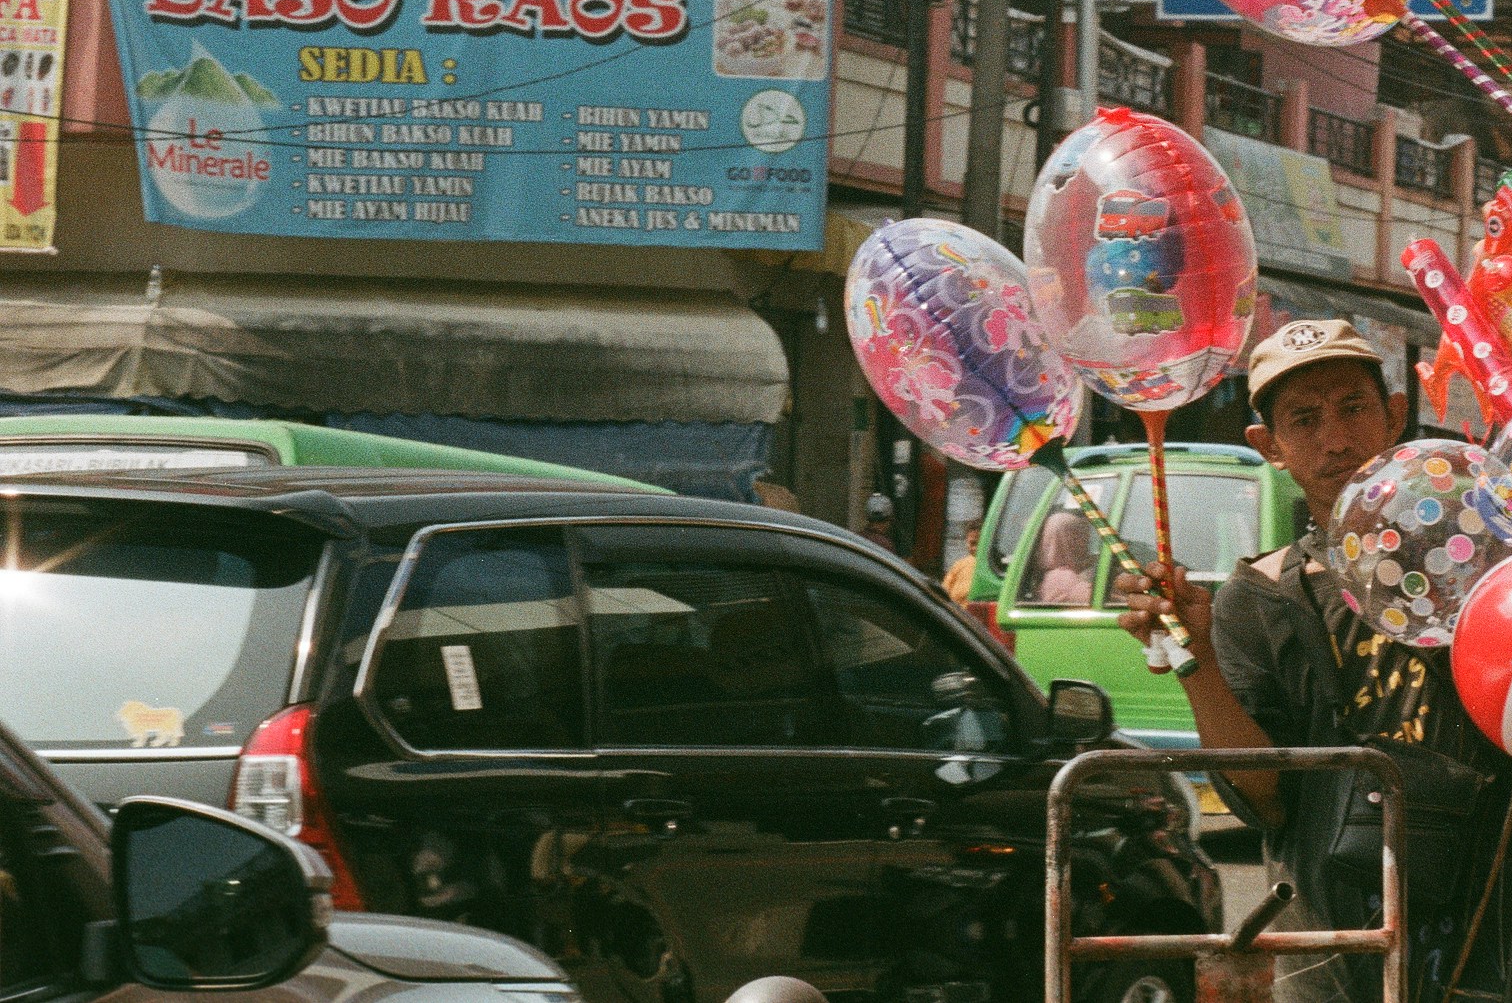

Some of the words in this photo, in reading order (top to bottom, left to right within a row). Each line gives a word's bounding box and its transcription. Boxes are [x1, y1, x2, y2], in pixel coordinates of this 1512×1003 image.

[299, 45, 428, 84] SEDIA
[306, 97, 406, 118] KWETIAU
[412, 98, 480, 119] BAKSO
[486, 101, 543, 121] KUAH
[577, 106, 641, 126] BIHUN
[646, 108, 710, 130] YAMIN
[188, 119, 223, 151] Le
[306, 124, 374, 143] BIHUN
[380, 124, 451, 145] BAKSO
[457, 126, 513, 146] KUAH
[577, 132, 613, 151] MIE
[620, 133, 681, 153] YAMIN
[147, 143, 271, 182] Minerale
[306, 148, 347, 169] MIE
[352, 149, 425, 170] BAKSO
[430, 151, 484, 171] KUAH
[577, 156, 613, 176] MIE
[619, 158, 671, 178] AYAM
[306, 175, 406, 195] KWETIAU
[412, 175, 473, 196] YAMIN
[576, 183, 638, 204] RUJAK
[644, 183, 714, 205] BAKSO
[306, 200, 347, 219] MIE
[352, 200, 407, 220] AYAM
[414, 202, 472, 223] HIJAU
[576, 208, 640, 228] ANEKA
[645, 209, 678, 230] JUS
[708, 211, 801, 233] MINUMAN
